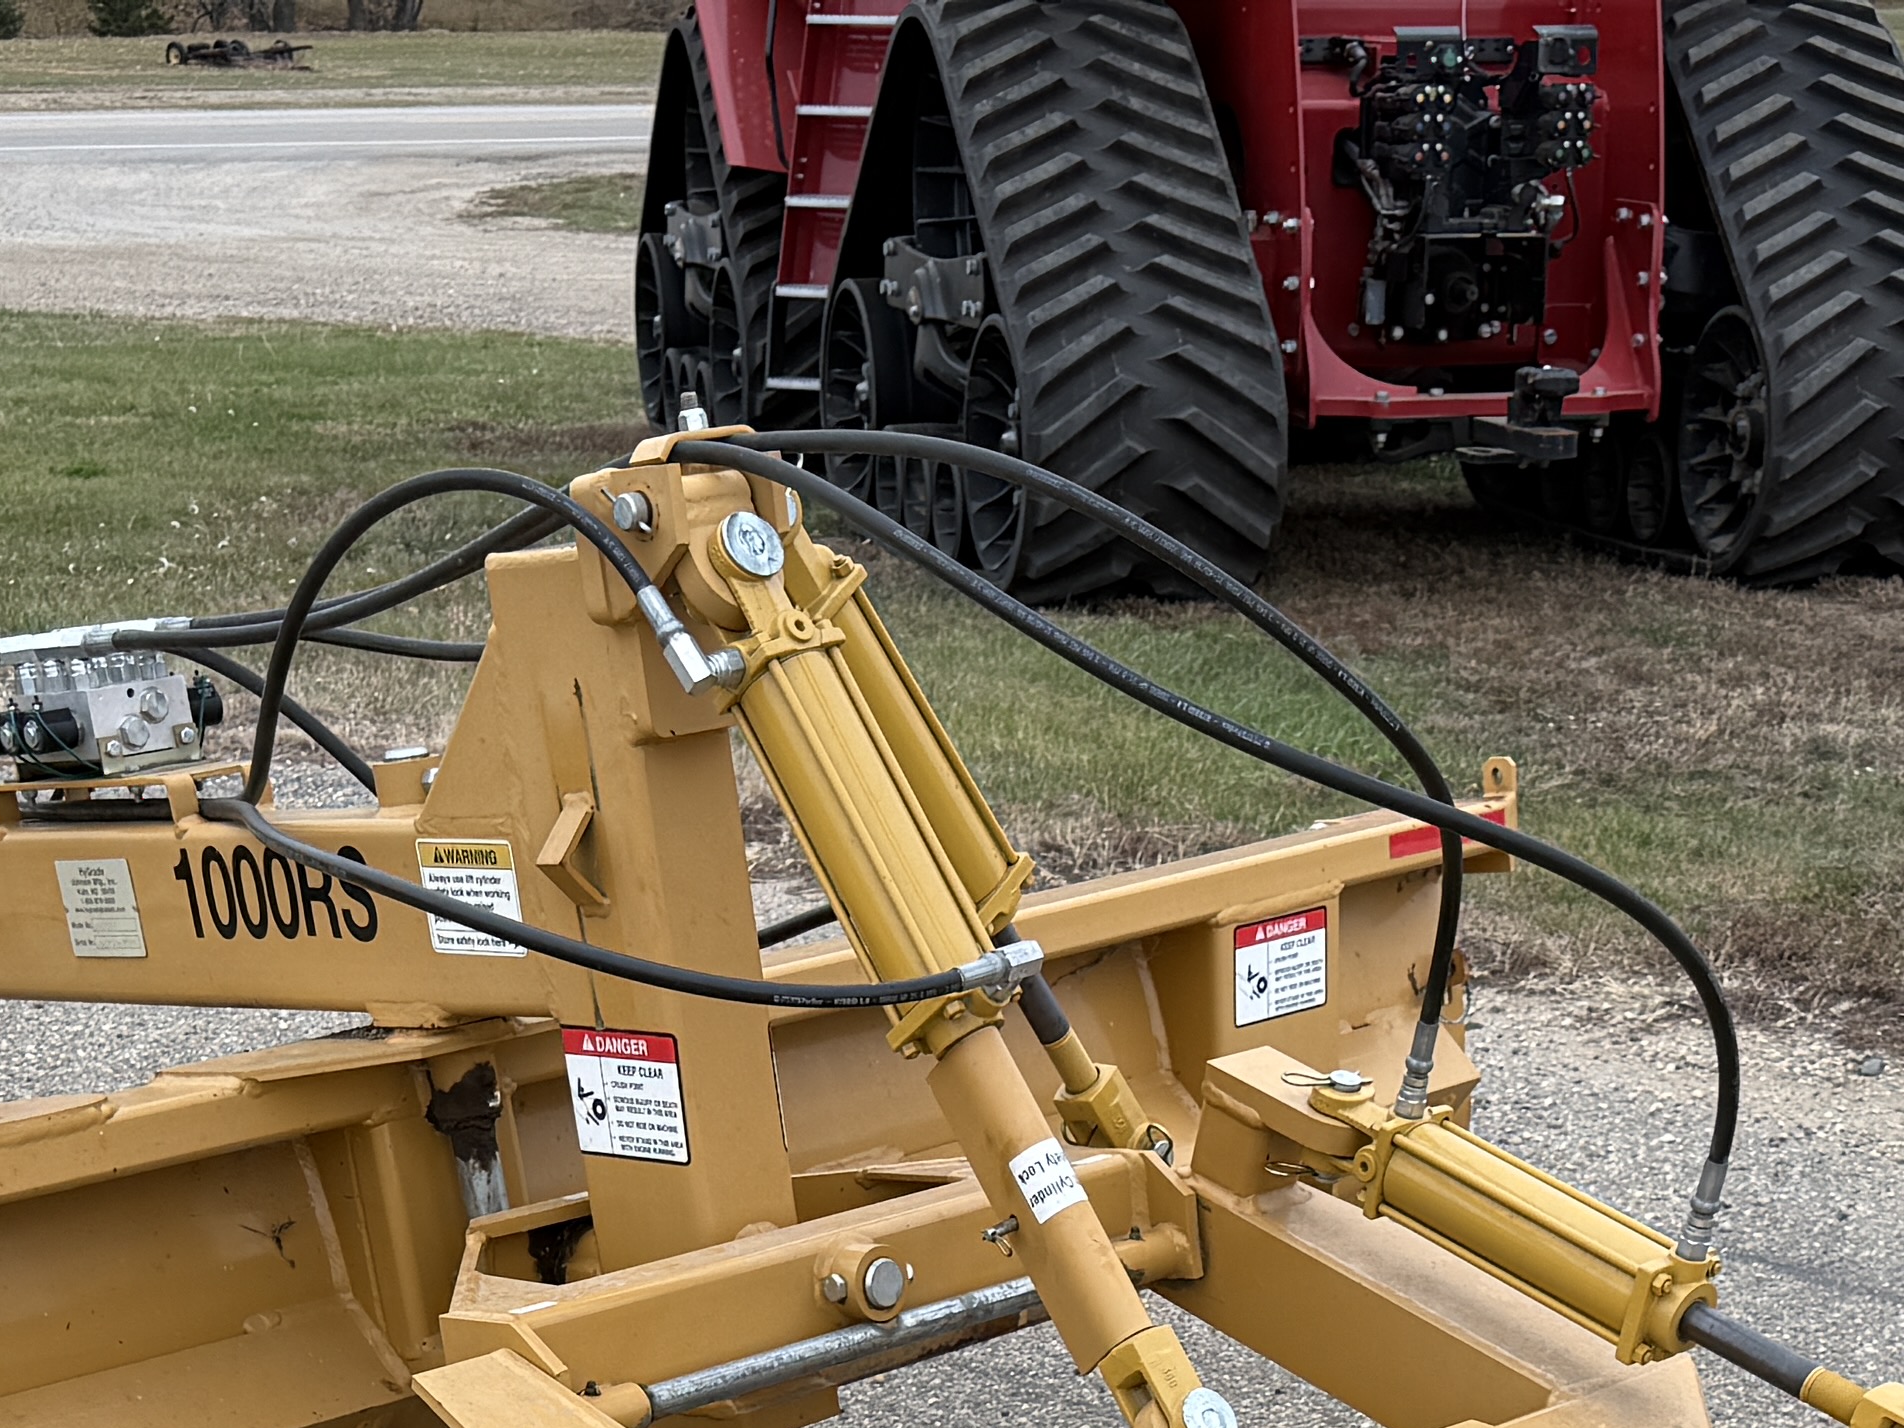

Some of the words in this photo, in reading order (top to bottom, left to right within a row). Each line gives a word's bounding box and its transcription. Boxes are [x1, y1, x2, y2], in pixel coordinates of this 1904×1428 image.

[443, 848, 497, 865] WARNING
[173, 845, 378, 942] 1000RS
[1266, 917, 1307, 938] DANGER
[595, 1036, 648, 1056] DANGER
[617, 1065, 637, 1077] KEEP
[638, 1066, 664, 1080] CLEAR
[1018, 1161, 1045, 1185] Lock
[1029, 1175, 1074, 1208] Cylinder
